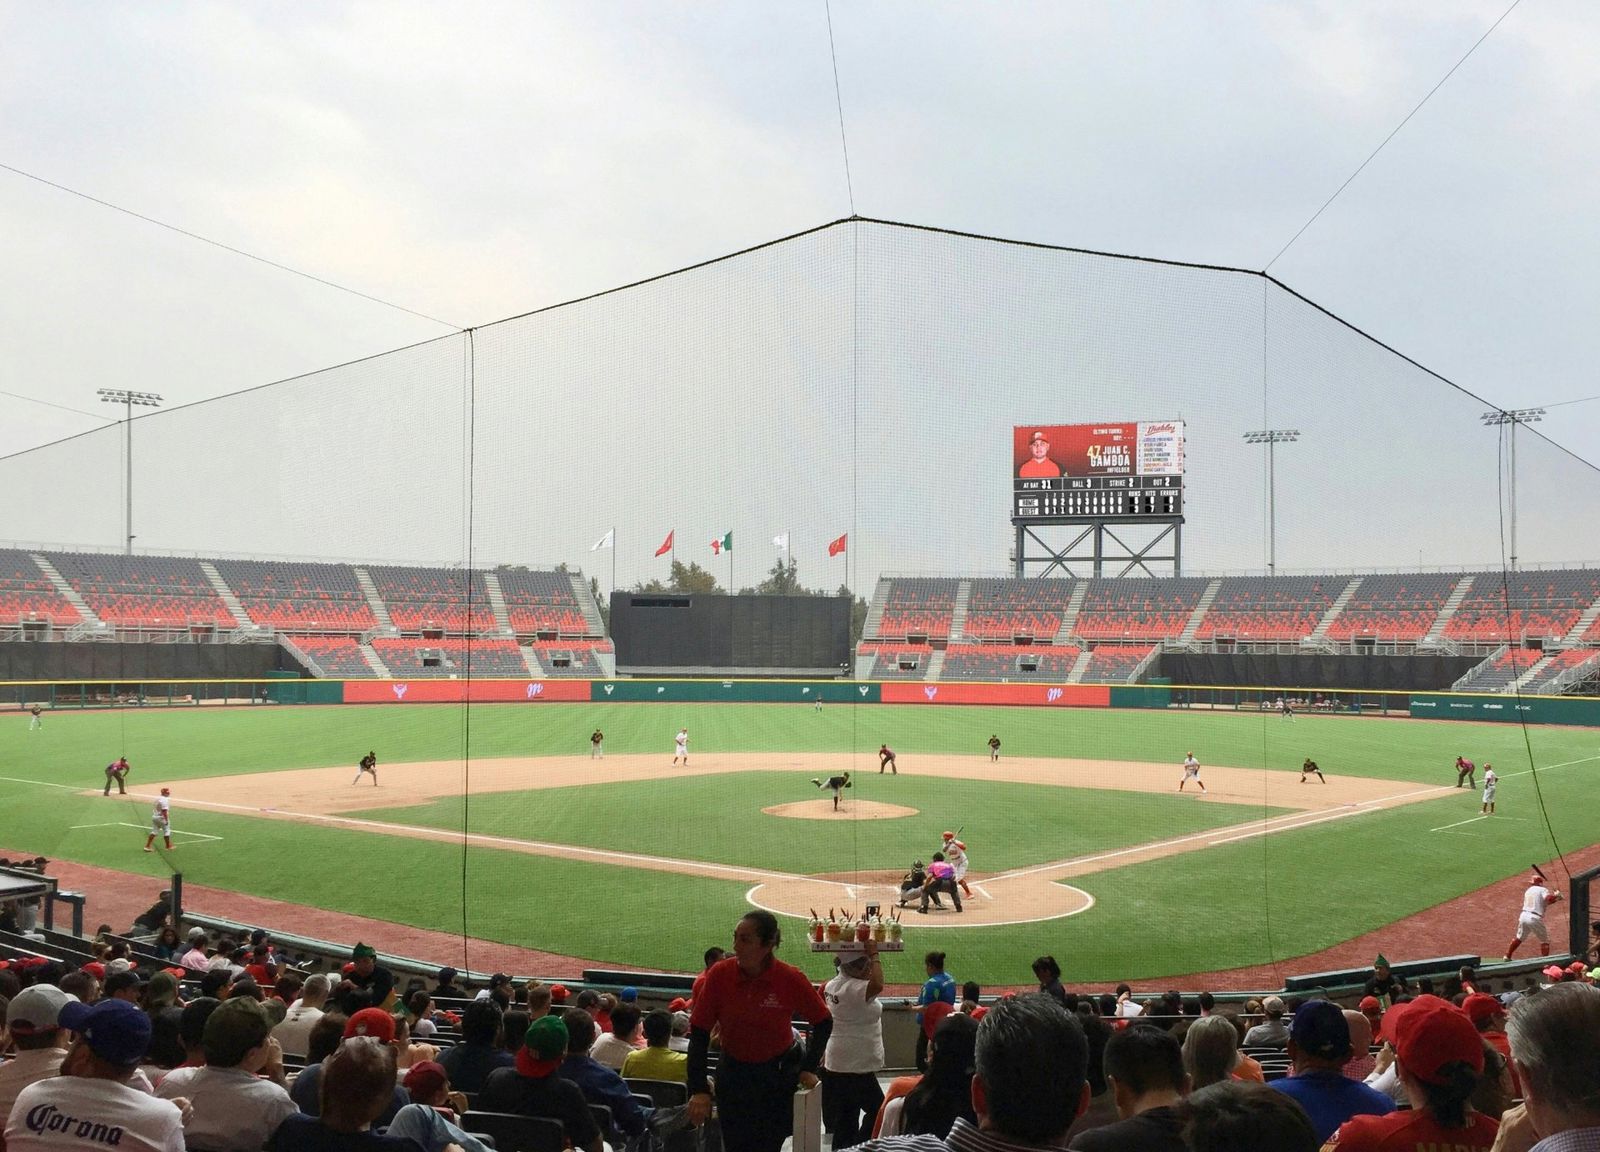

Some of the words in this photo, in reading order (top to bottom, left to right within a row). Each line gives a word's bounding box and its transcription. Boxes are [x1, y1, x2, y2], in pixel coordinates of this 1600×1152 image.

[1087, 446, 1101, 458] 47
[1102, 446, 1121, 454] JUAN
[1122, 446, 1130, 454] C.
[1090, 454, 1130, 467] GAMBOA
[1042, 480, 1051, 489] 31
[1086, 479, 1091, 488] 3
[1129, 478, 1134, 487] 2
[1165, 477, 1170, 486] 2
[26, 1104, 124, 1146] Corona
